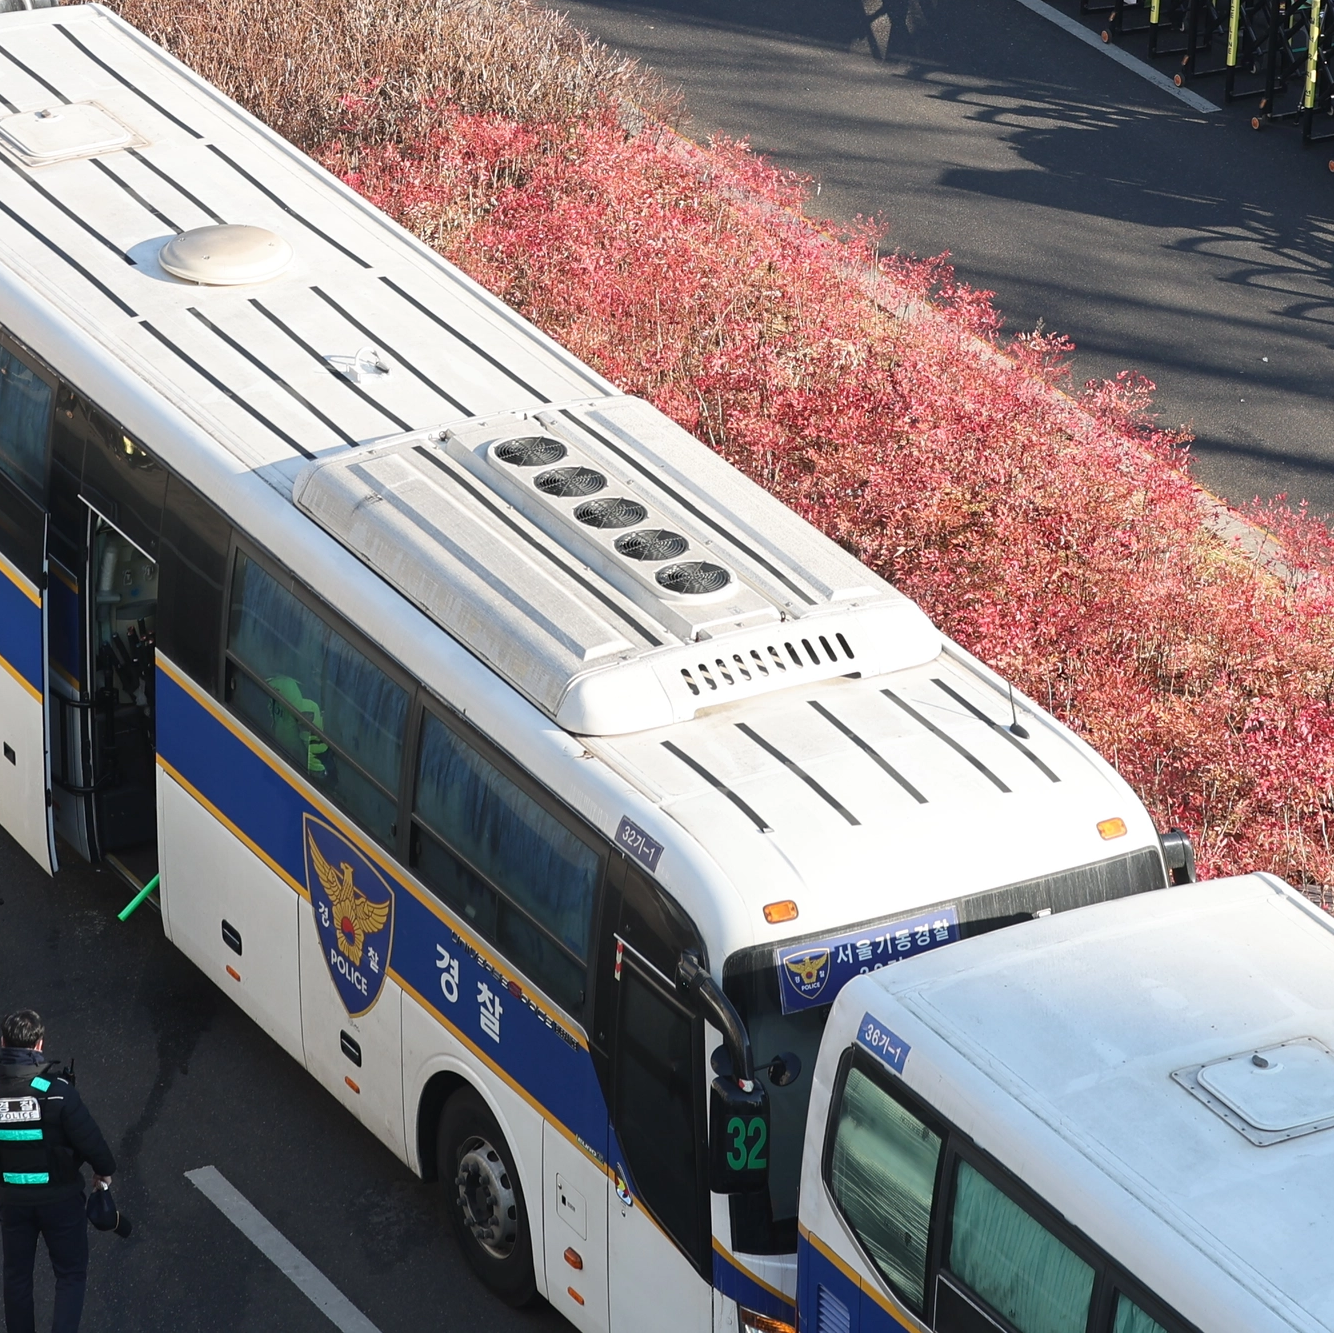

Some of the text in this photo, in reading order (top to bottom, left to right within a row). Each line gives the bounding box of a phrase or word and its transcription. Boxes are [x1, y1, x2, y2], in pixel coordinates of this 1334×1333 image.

[621, 826, 655, 862] 32기-1
[317, 901, 379, 974] 경 찰
[836, 917, 950, 965] 서울기동경찰
[329, 948, 368, 996] POLICE
[436, 944, 503, 1044] 경찰
[801, 981, 821, 990] POLICE
[865, 1023, 902, 1062] 36기-1
[726, 1116, 767, 1170] 32
